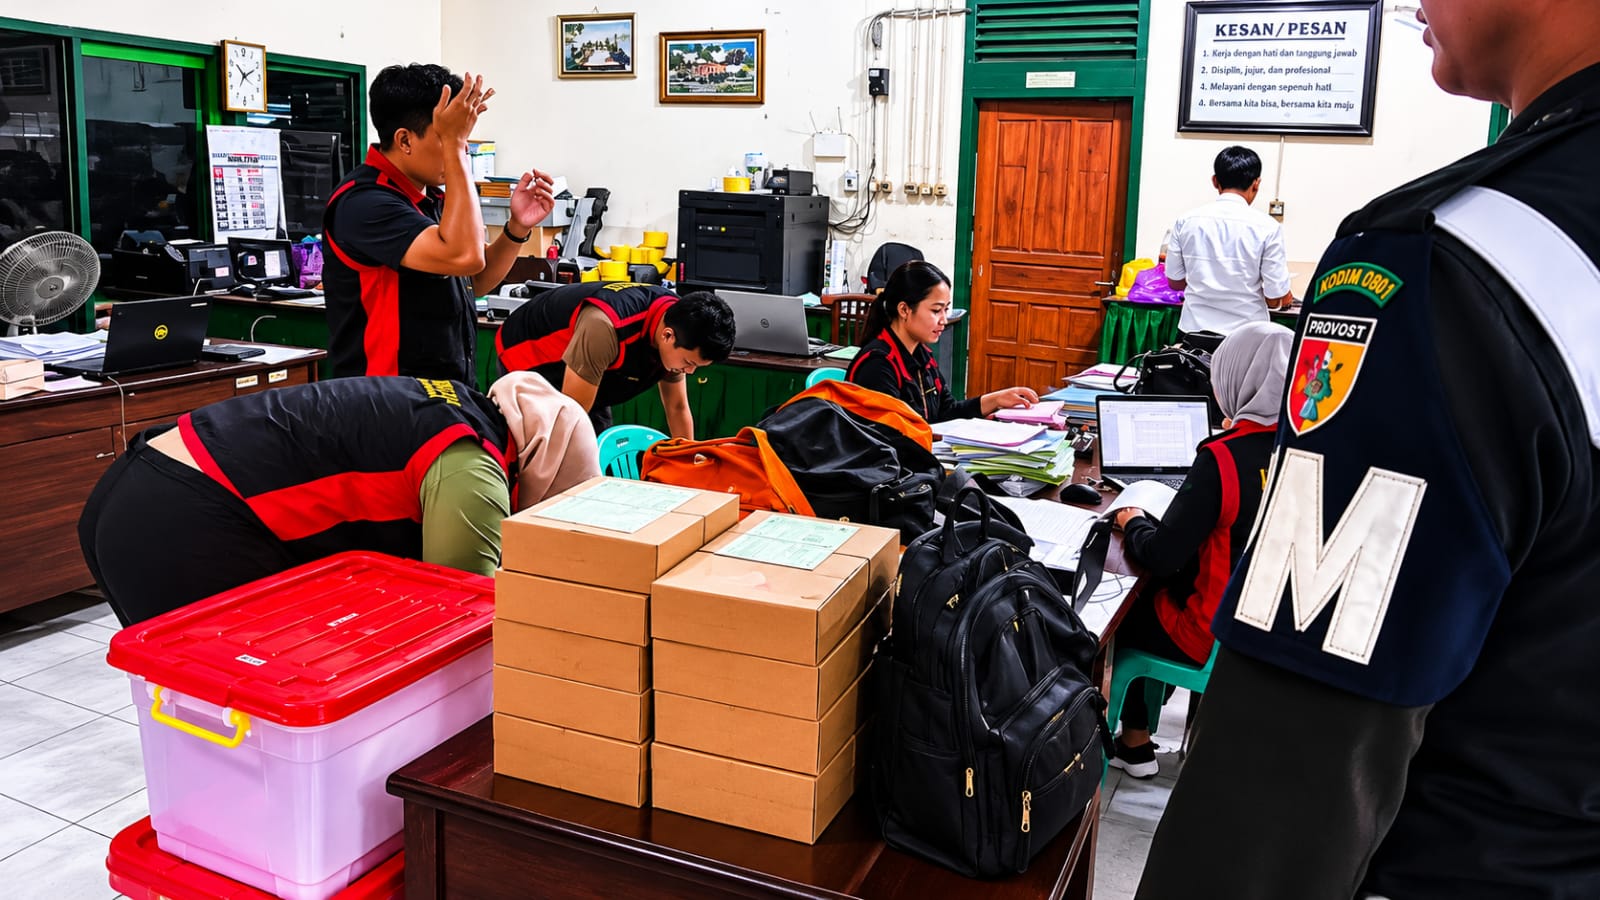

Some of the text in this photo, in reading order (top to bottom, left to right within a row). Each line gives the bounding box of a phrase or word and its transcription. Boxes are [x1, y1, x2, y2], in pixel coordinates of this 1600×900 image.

[1215, 21, 1347, 37] KESAN/PESAN
[1212, 49, 1231, 59] Kerja
[1233, 49, 1262, 59] dengan
[1263, 49, 1278, 57] hati
[1279, 49, 1294, 57] dan
[1296, 49, 1331, 59] tanggung
[1333, 48, 1357, 59] jawab
[1201, 66, 1331, 76] 2. Disiplin, jujur, dan profesional
[1210, 83, 1245, 93] Melayani
[1247, 83, 1276, 93] dengan
[1279, 83, 1313, 93] sepenuh
[1209, 99, 1242, 107] Bersama
[1244, 99, 1259, 108] kita
[1260, 99, 1279, 109] bisa,
[1281, 100, 1315, 108] bersama
[1317, 100, 1332, 109] kita
[1334, 101, 1354, 111] maju
[1319, 268, 1396, 300] KODIM 0801
[1308, 320, 1367, 339] PROVOST
[1234, 447, 1427, 665] M
